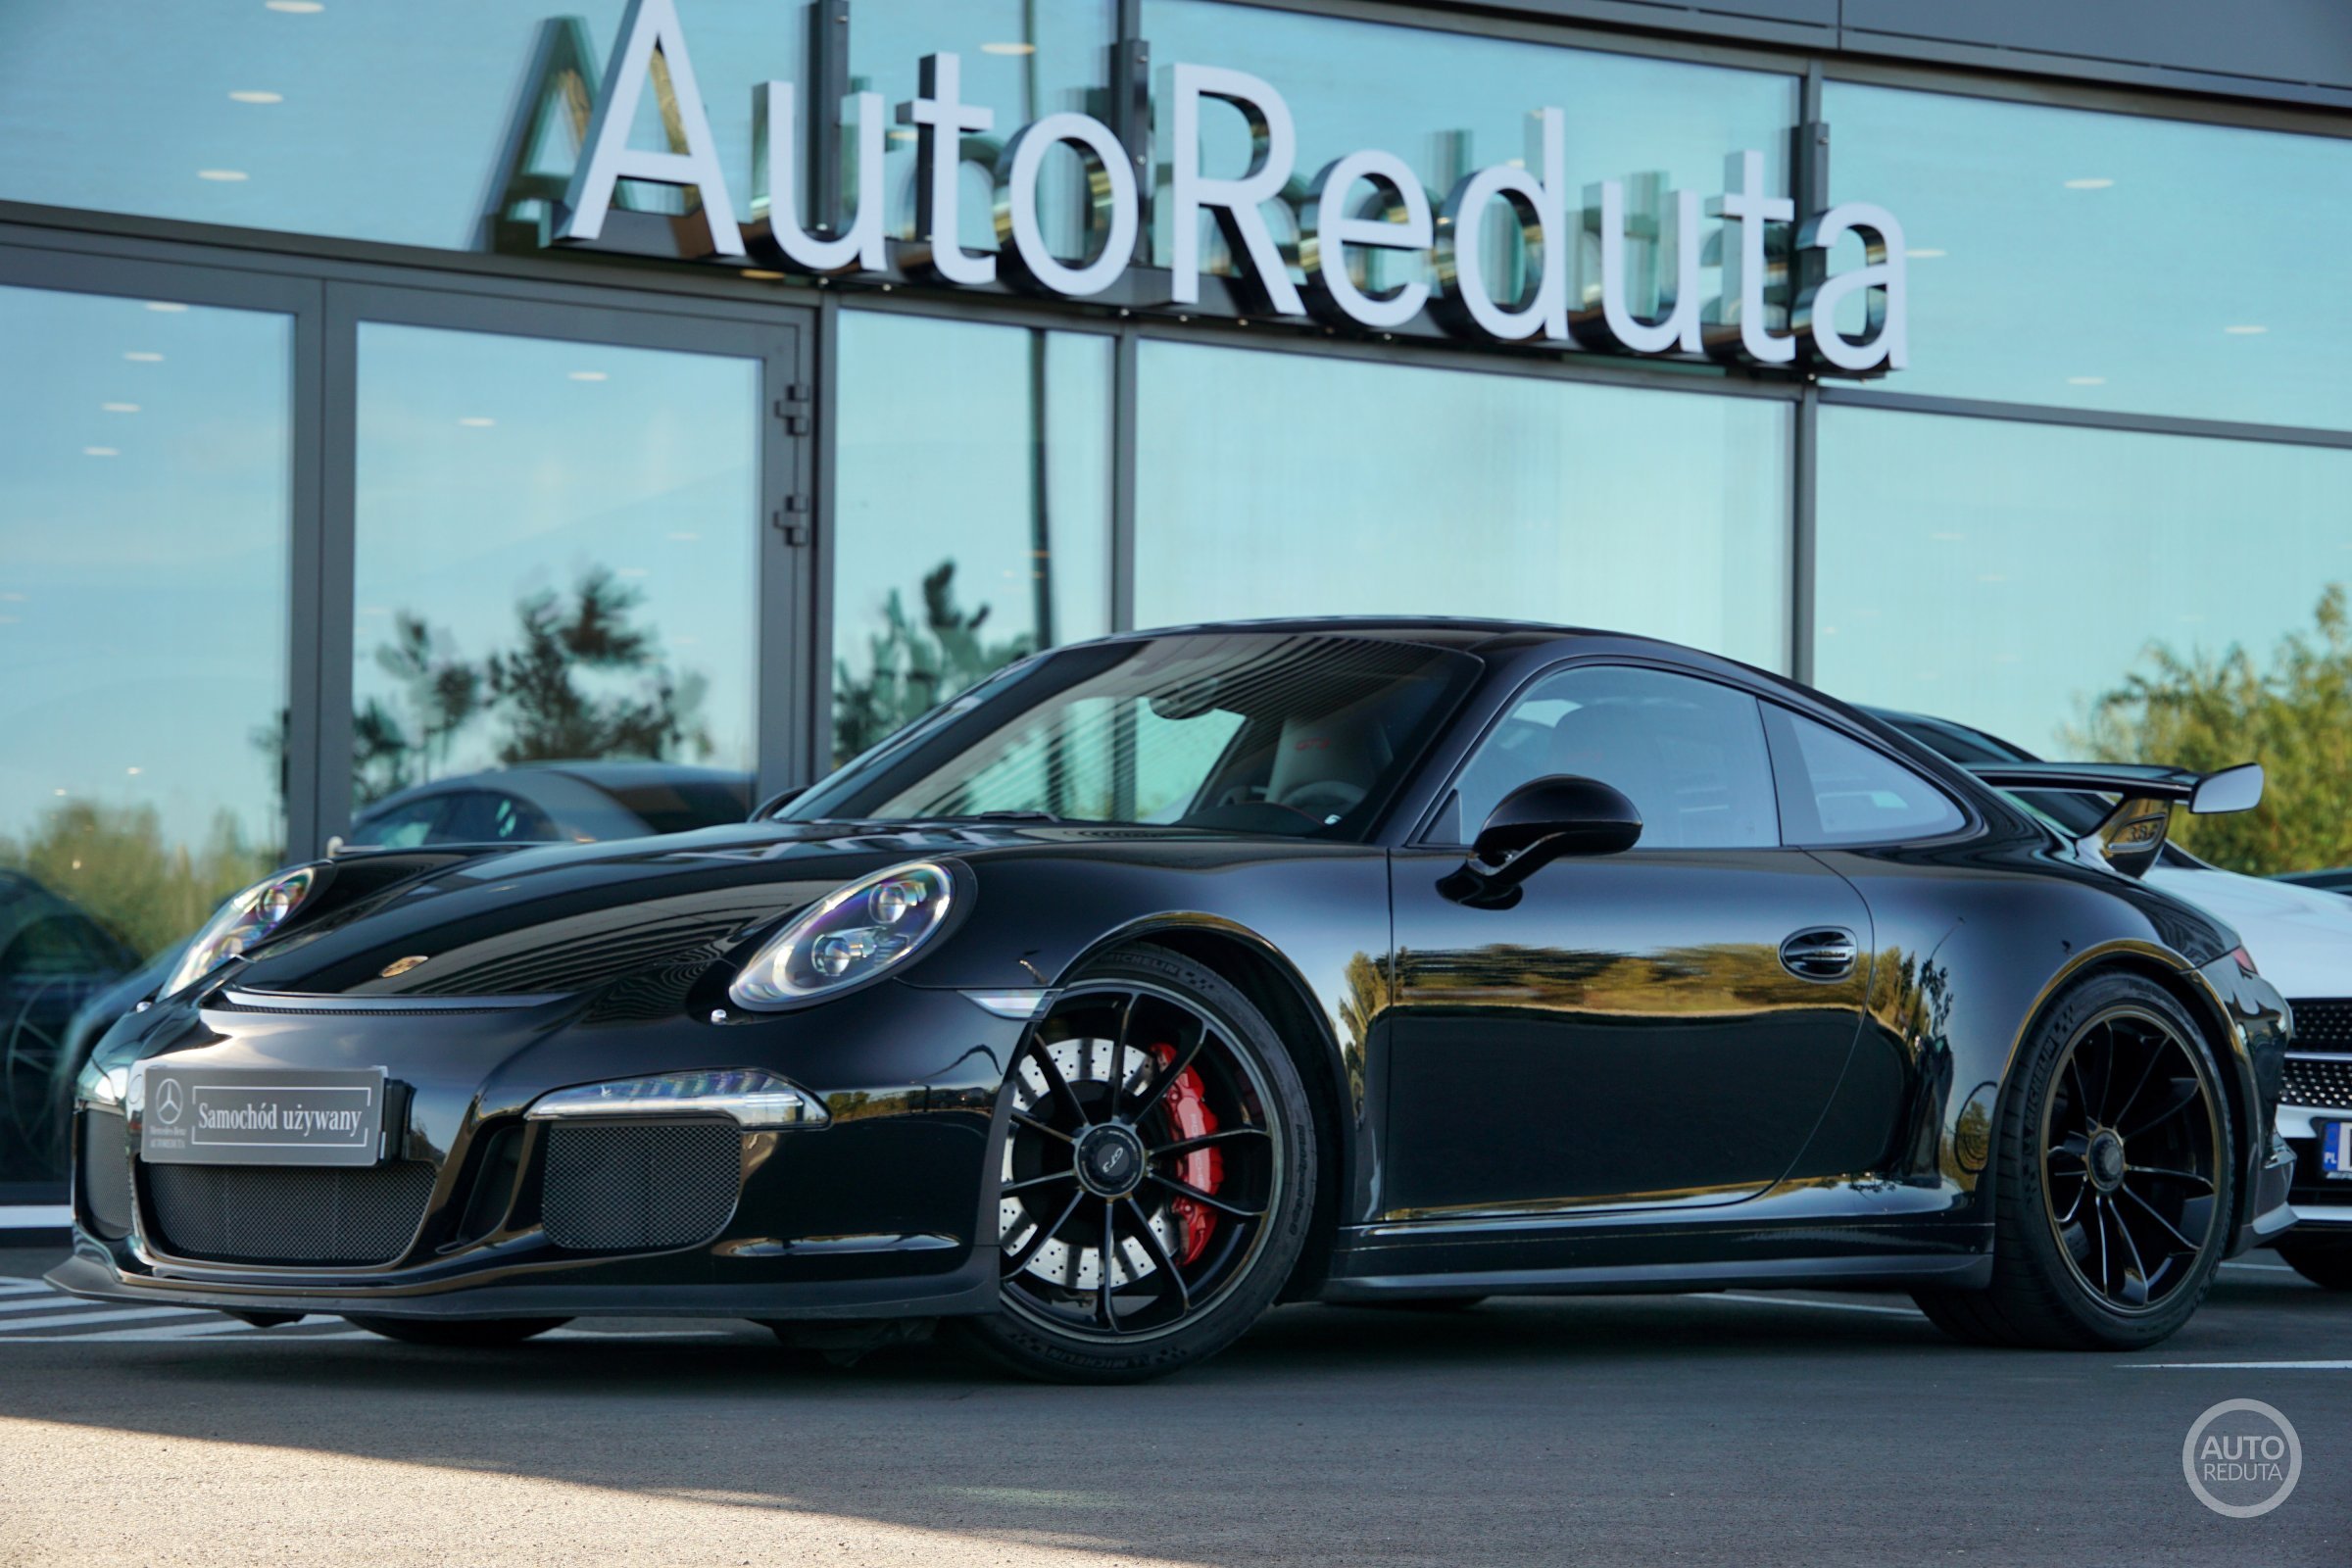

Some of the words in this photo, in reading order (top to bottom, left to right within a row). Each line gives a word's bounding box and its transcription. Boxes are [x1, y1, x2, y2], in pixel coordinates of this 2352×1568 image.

[556, 0, 1908, 372] AutoReduta
[198, 1102, 278, 1132] Samochód
[282, 1103, 363, 1138] używany
[1102, 1147, 1124, 1173] GT3
[2324, 1152, 2337, 1164] PL
